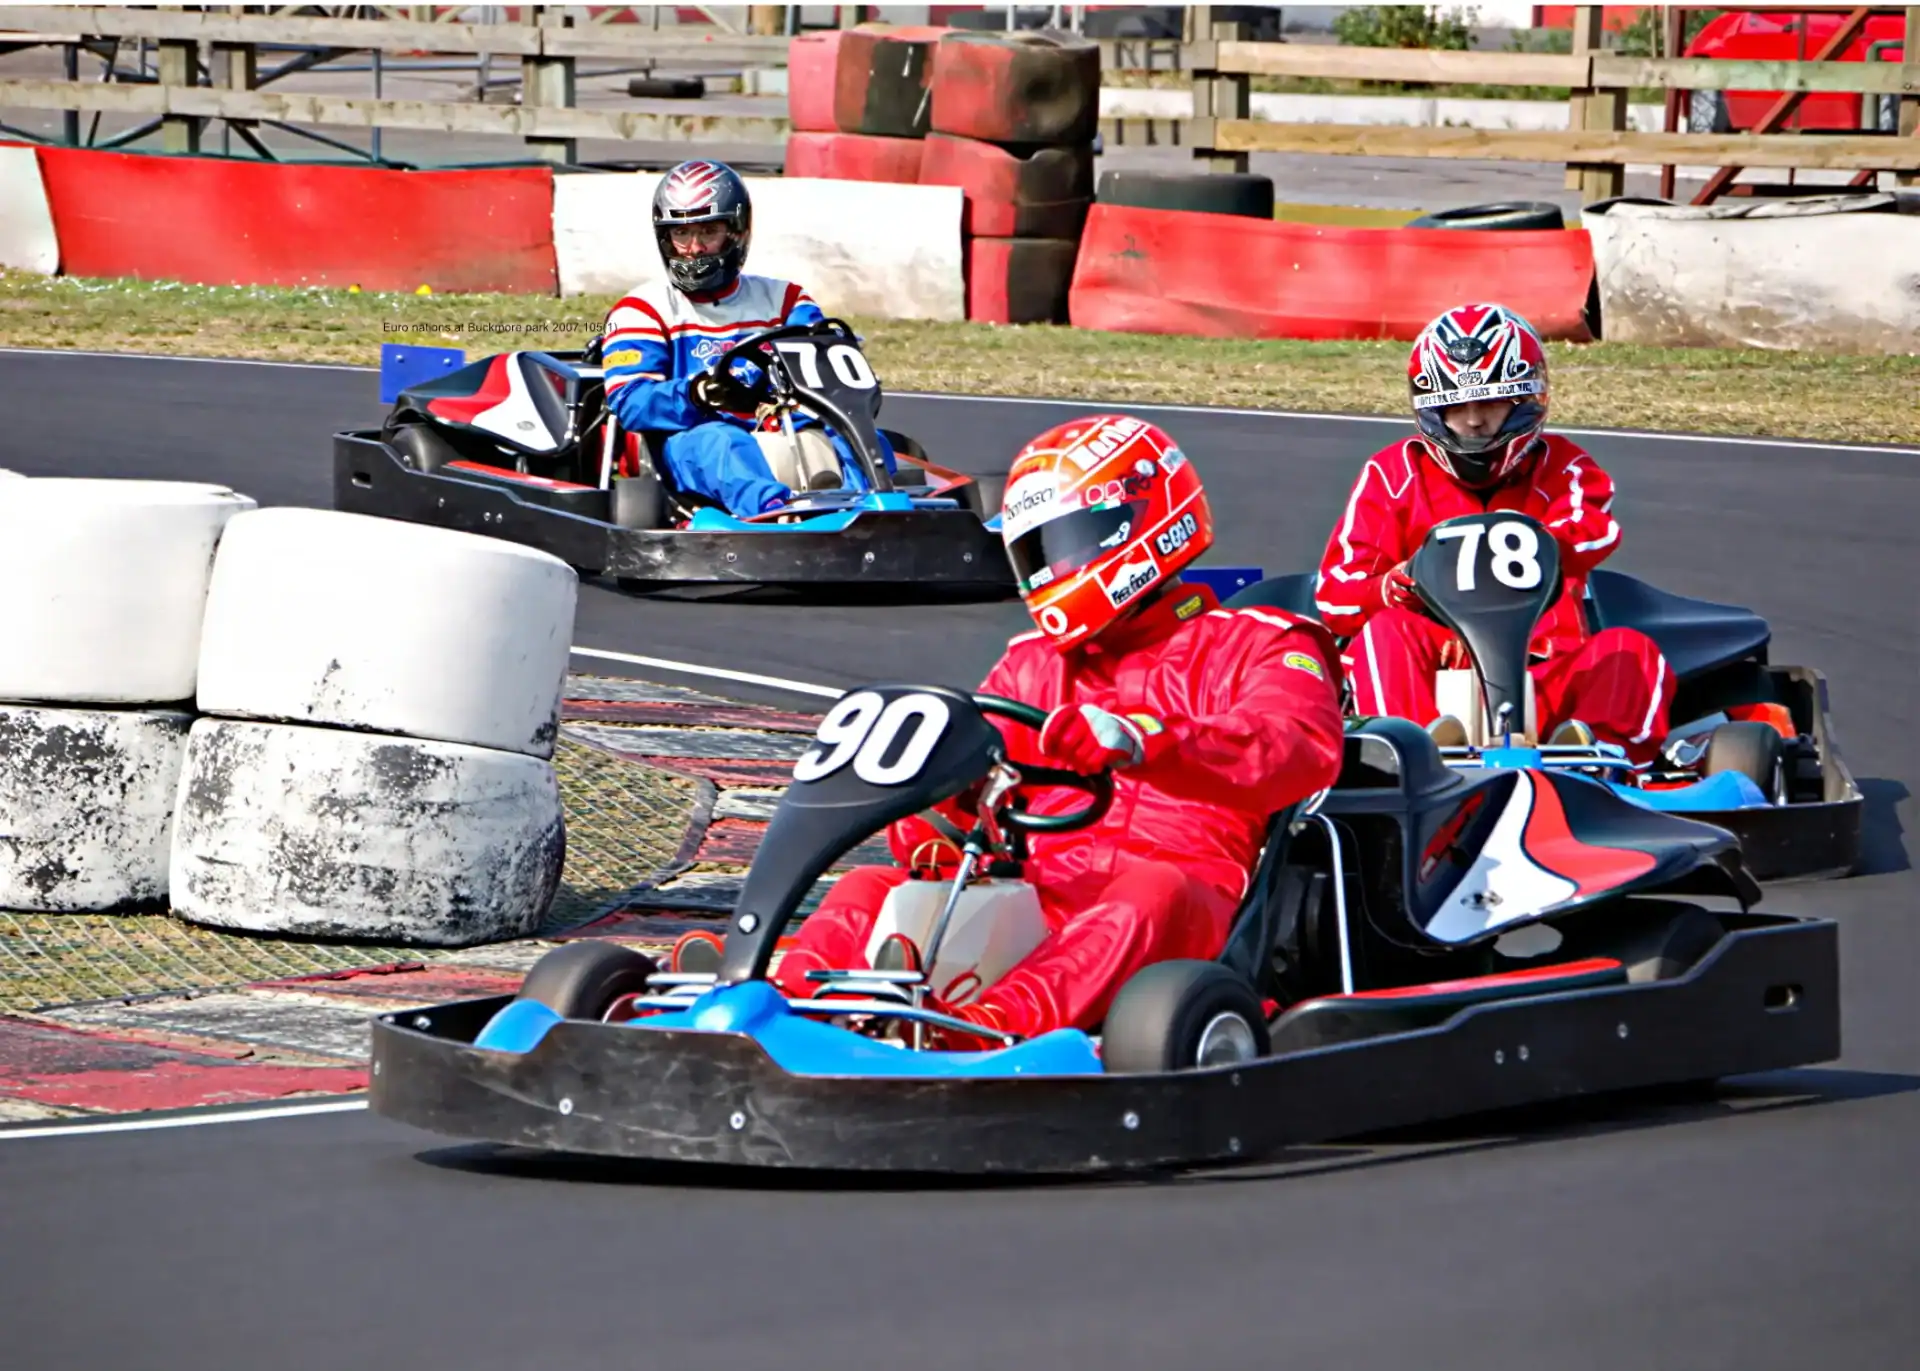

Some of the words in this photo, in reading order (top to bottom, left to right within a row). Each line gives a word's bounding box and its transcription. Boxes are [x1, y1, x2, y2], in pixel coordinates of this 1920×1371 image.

[773, 342, 878, 390] 70
[1435, 521, 1542, 592] 78
[793, 691, 950, 785] 90
